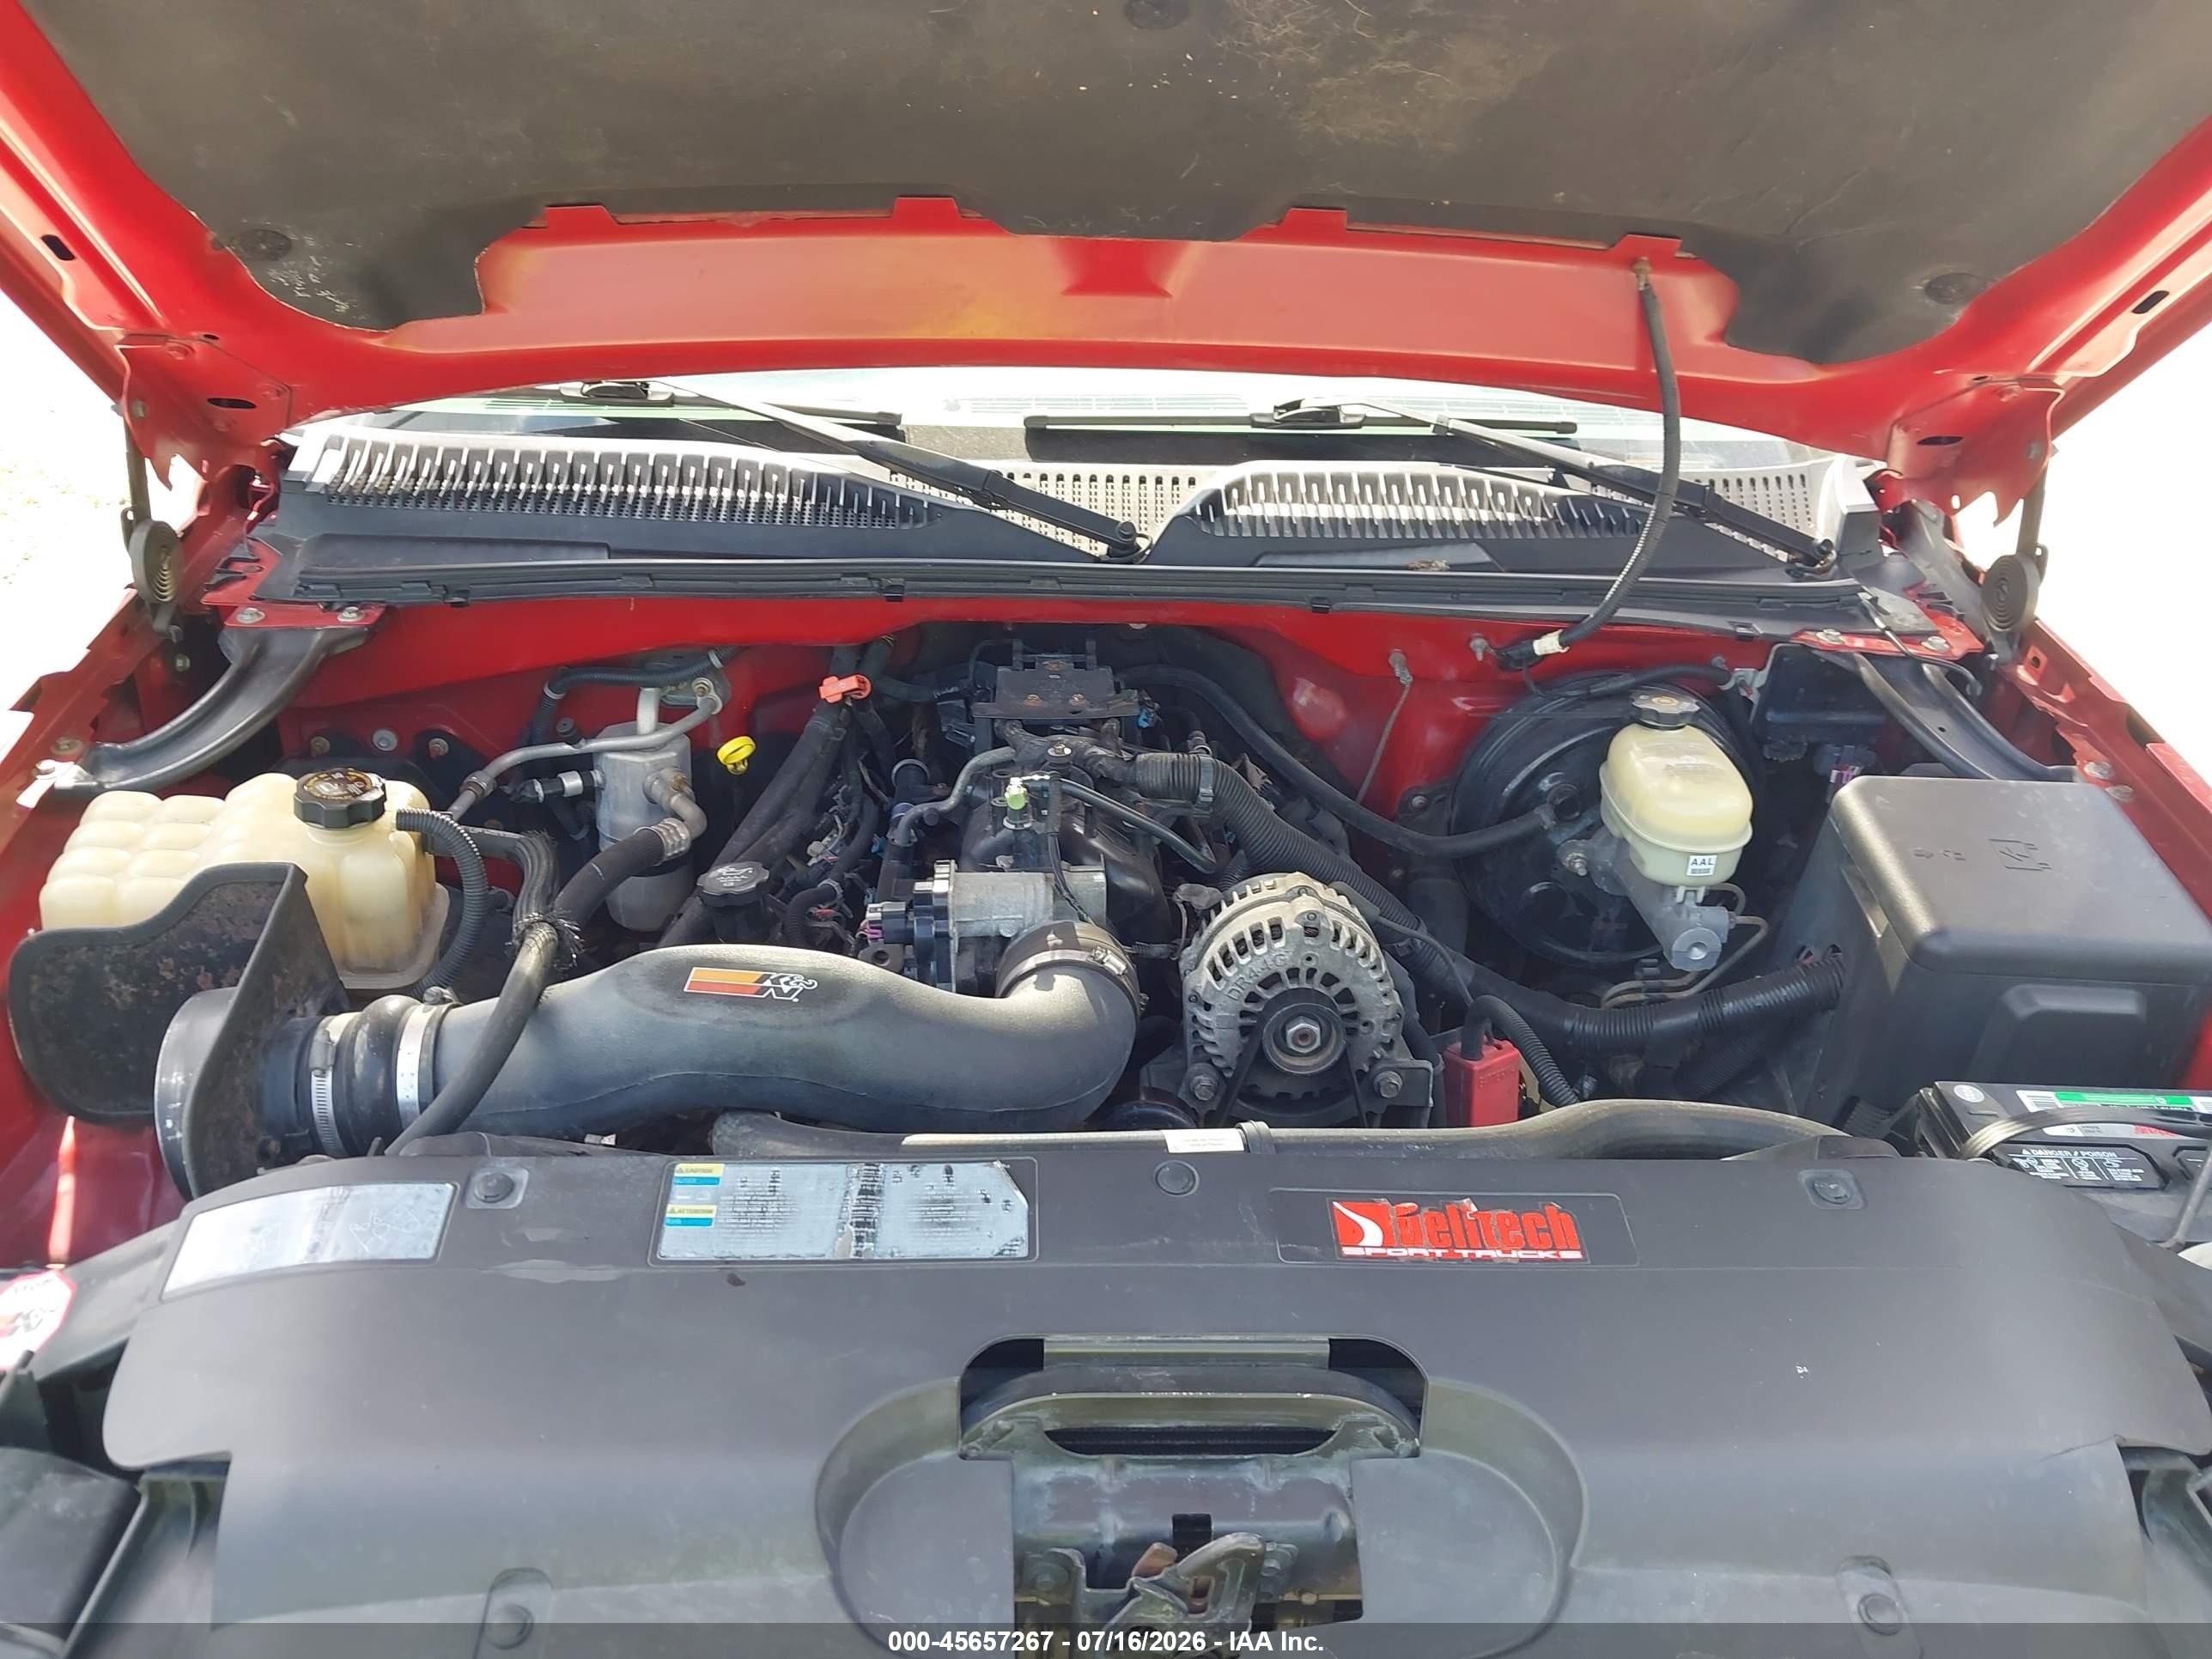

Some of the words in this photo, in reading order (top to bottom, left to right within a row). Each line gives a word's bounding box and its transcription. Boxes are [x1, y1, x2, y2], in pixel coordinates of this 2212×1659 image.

[1690, 858, 1715, 866] AAL
[1341, 1246, 1449, 1258] SPORT
[1455, 1248, 1583, 1259] TRUCKS
